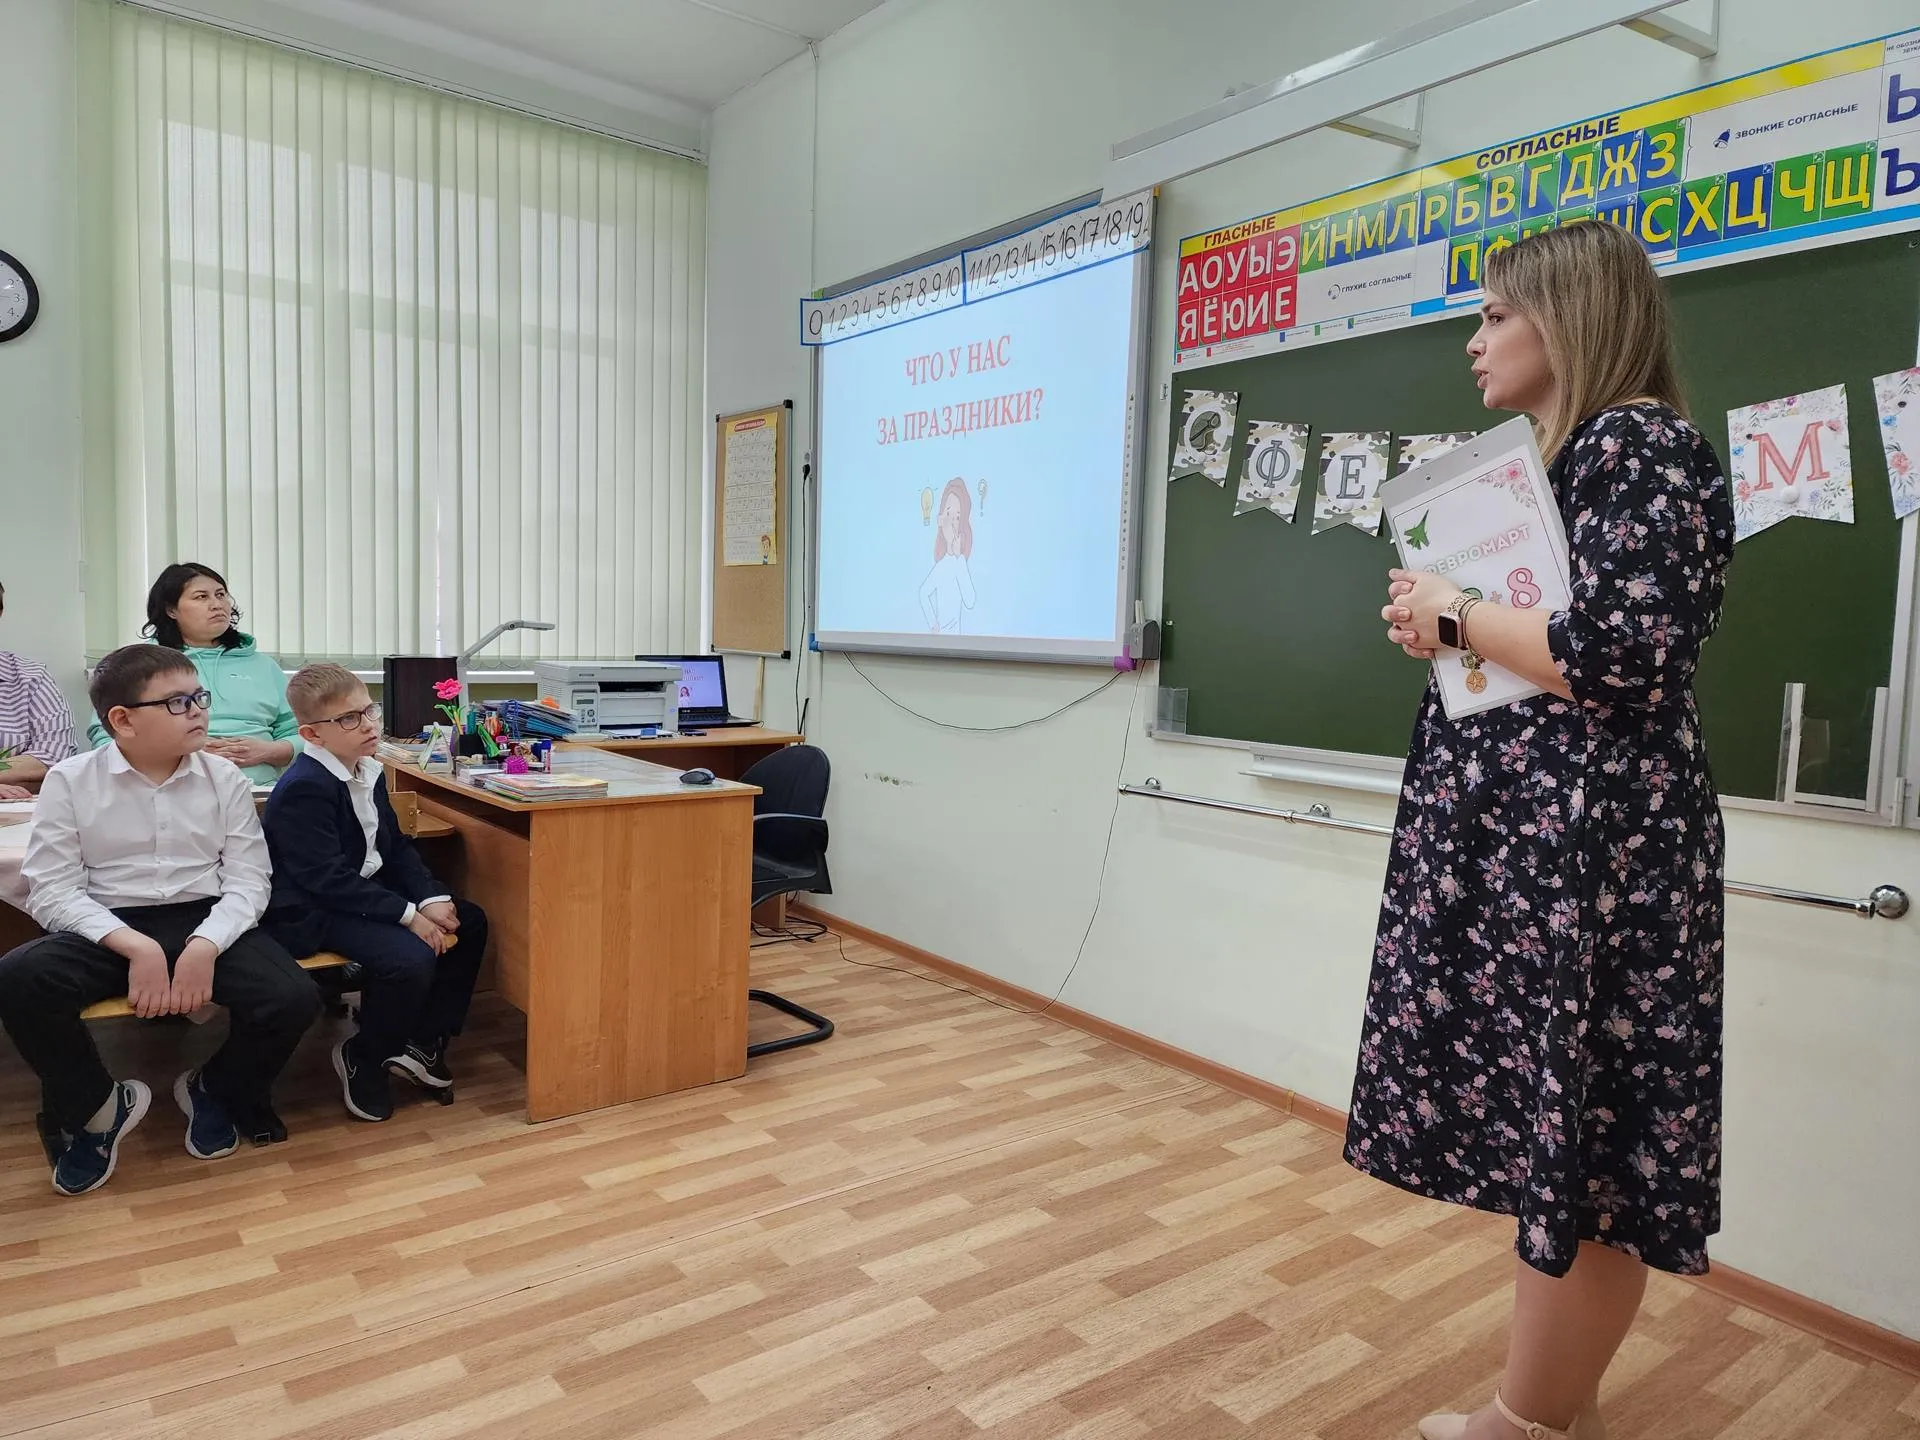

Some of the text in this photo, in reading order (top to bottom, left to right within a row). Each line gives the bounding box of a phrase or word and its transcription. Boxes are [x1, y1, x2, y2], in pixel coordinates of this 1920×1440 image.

[1476, 116, 1621, 170] СОГЛАСНЫЕ
[1735, 103, 1859, 140] ЗВОНКИЕ СОГЛАСНЫЕ
[1302, 132, 1677, 266] Й Н М Л Р Б В Г Д Ж З
[1450, 243, 1480, 285] П
[1640, 197, 1675, 244] С
[1682, 185, 1720, 236] Х
[1727, 175, 1767, 230] Ц
[1779, 164, 1818, 213] Ч
[1823, 153, 1871, 210] Щ
[969, 258, 983, 290] 11
[984, 253, 1001, 287] 12
[1003, 247, 1019, 281] 13
[1021, 241, 1037, 276] 14
[1039, 232, 1057, 268] 15
[1058, 224, 1077, 262] 16
[1079, 216, 1101, 255] 17
[1102, 209, 1123, 249] 18
[1125, 202, 1144, 241] 19
[1204, 216, 1276, 249] ГЛАСНЫЕ
[1179, 235, 1297, 298] А О У Ы Э
[1341, 272, 1412, 293] ГЛУХИЕ СОГЛАСНЫЕ
[808, 266, 961, 336] 0 1 2 3 4 5 6 7 8 9 10
[1179, 286, 1292, 343] Я Ё Ю И Е
[905, 335, 1011, 386] ЧТО У НАС
[876, 388, 1045, 446] ЗА ПРАЗДНИКИ?
[1255, 439, 1367, 500] Ф Е
[1751, 420, 1830, 492] М
[1506, 567, 1542, 609] 8
